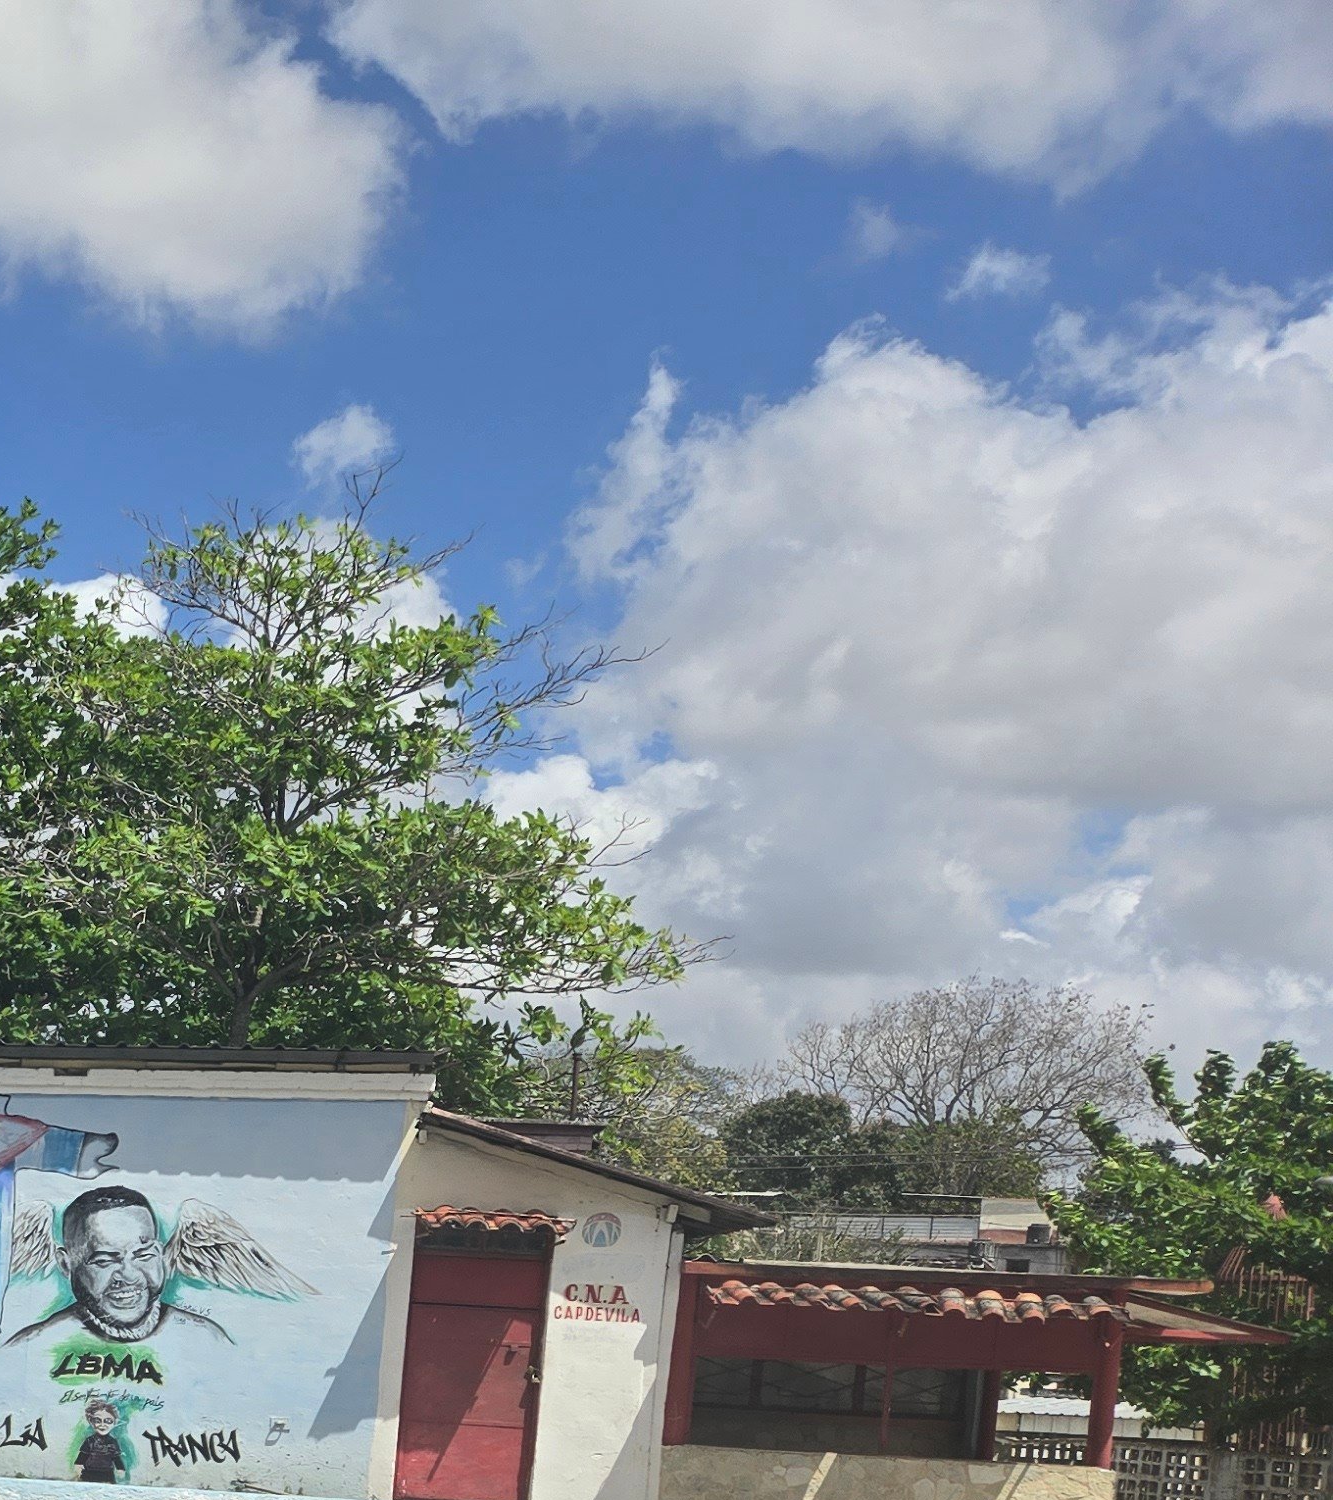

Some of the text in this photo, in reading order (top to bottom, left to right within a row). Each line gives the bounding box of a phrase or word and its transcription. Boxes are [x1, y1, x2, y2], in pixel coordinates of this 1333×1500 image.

[565, 1284, 629, 1304] C.N.A
[554, 1305, 640, 1322] CAPDEVILA
[52, 1352, 163, 1385] LBMA
